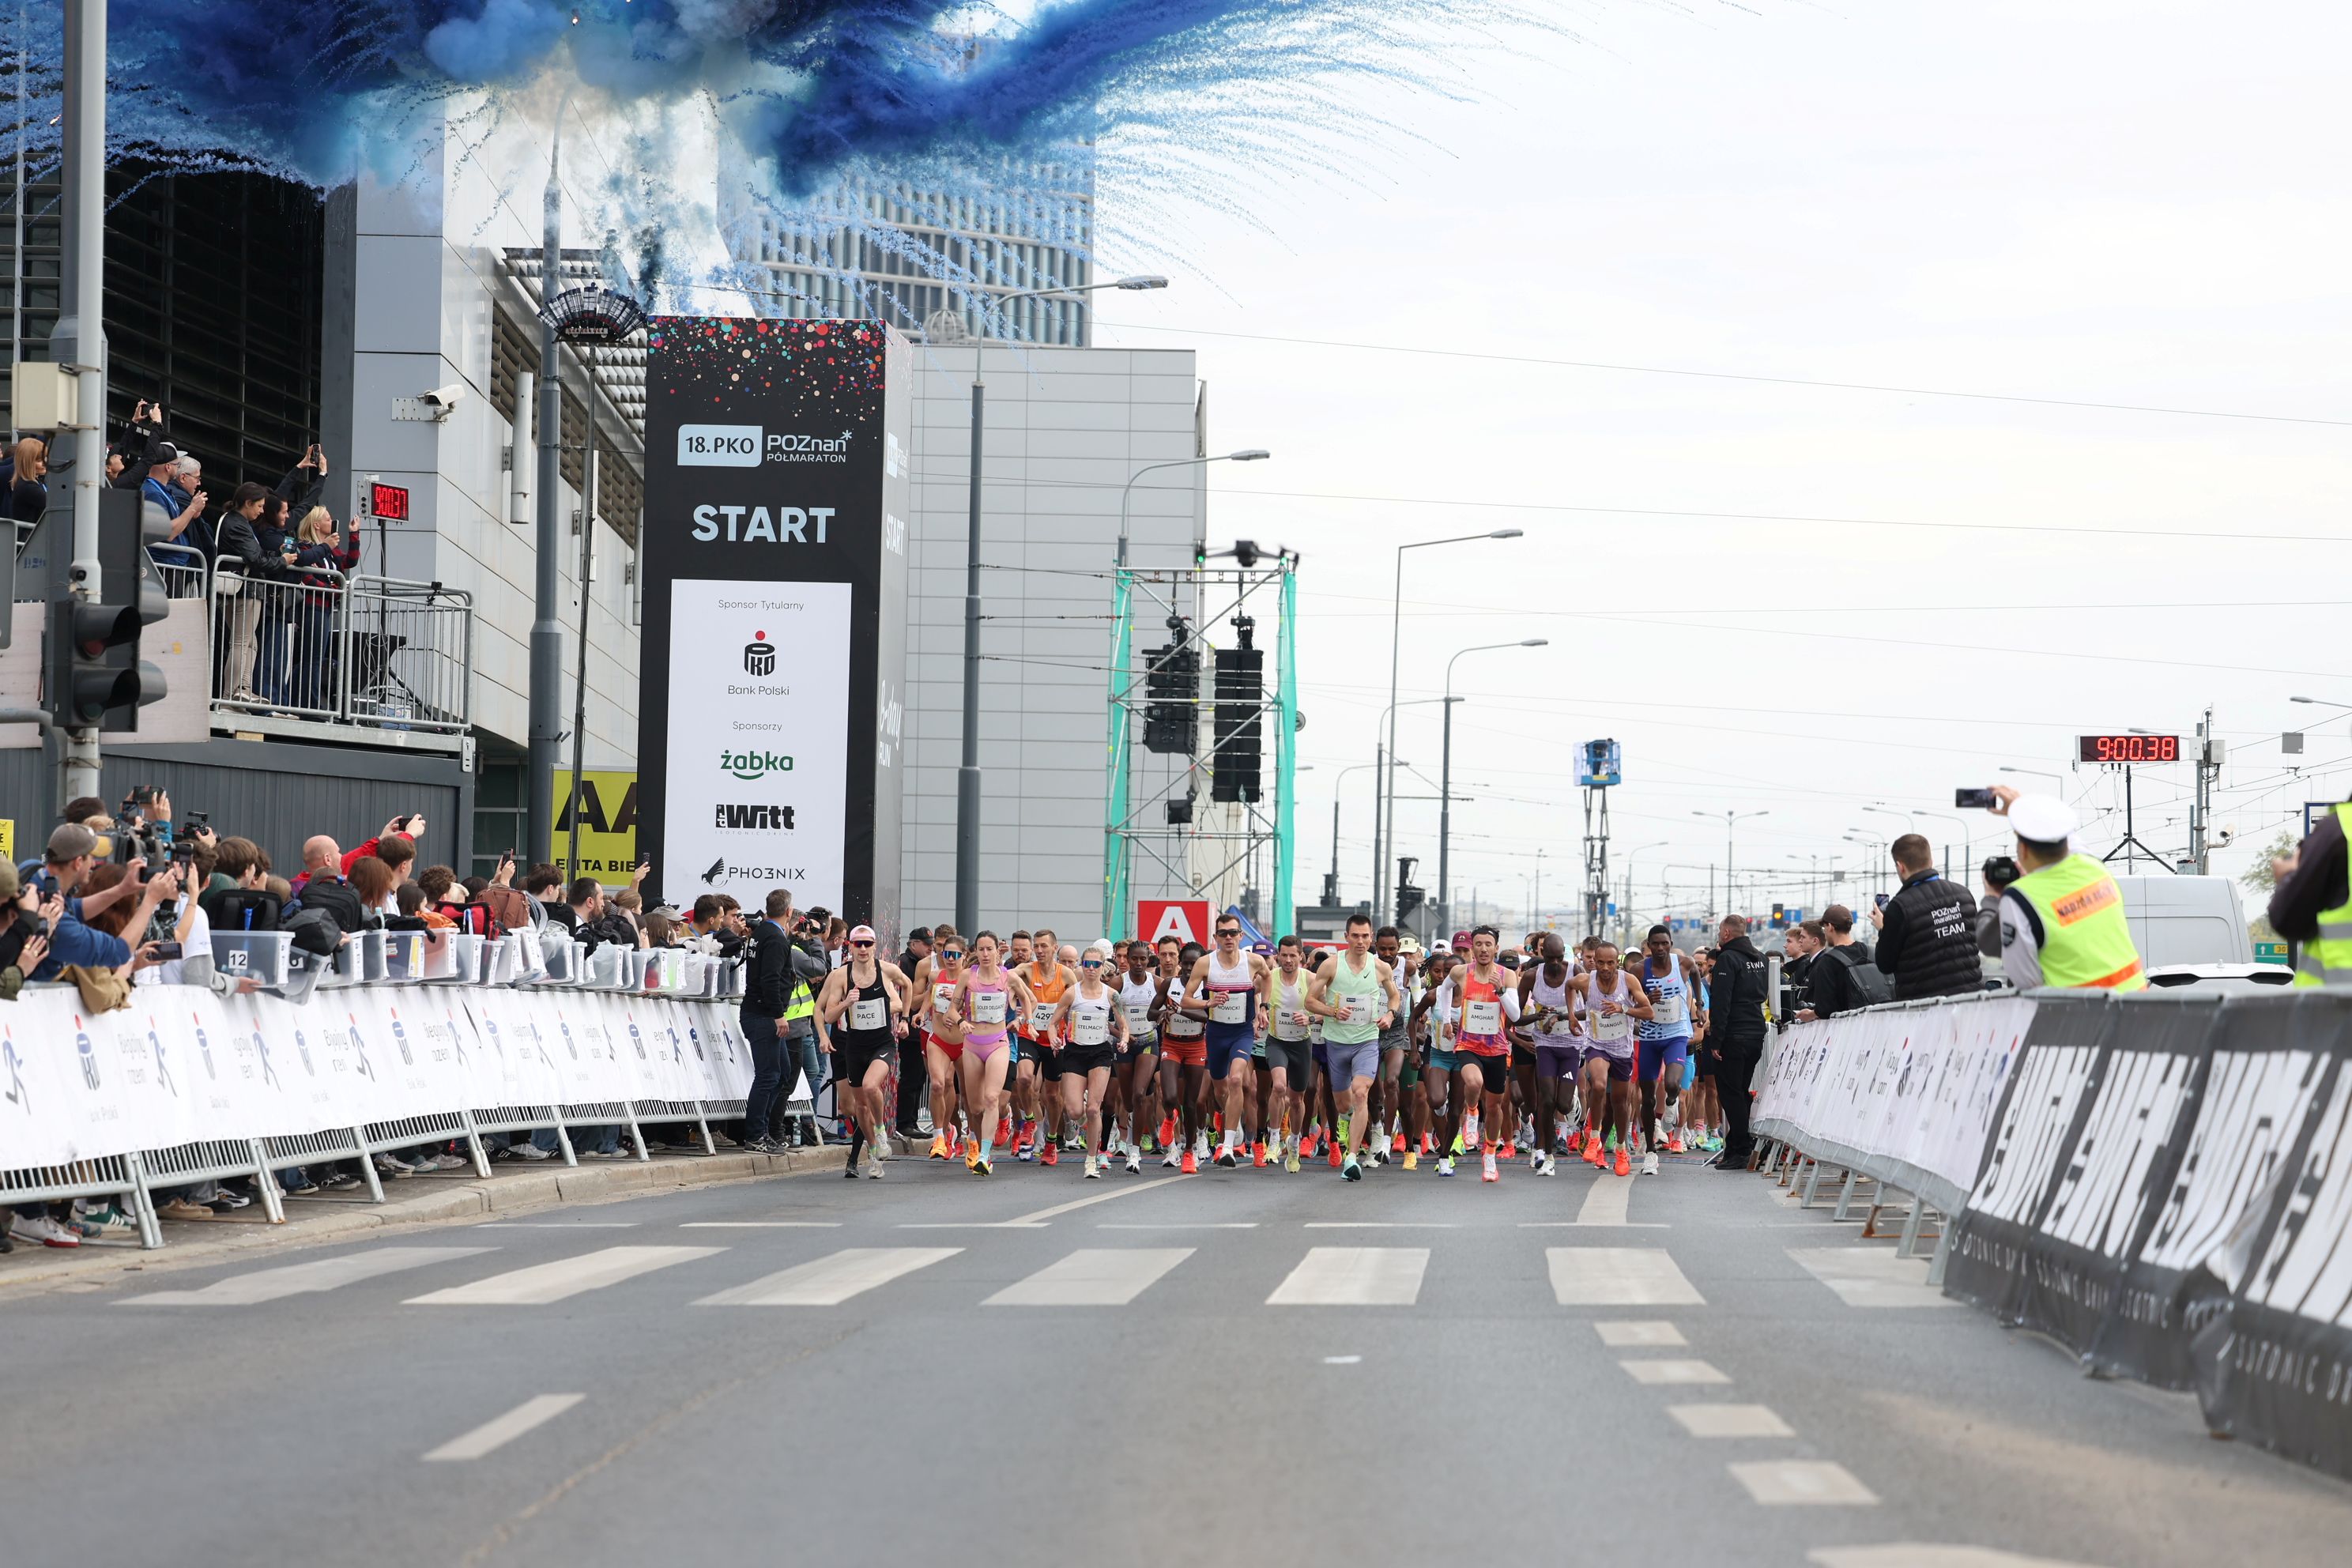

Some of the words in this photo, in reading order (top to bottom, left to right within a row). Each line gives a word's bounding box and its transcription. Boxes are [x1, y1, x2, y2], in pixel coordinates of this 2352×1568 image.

[686, 436, 755, 454] 18.PKO
[767, 452, 846, 463] PÓŁMARATON
[692, 504, 835, 544] START
[886, 513, 905, 556] START
[718, 599, 758, 611] Sponsor
[761, 600, 805, 612] Tytularny
[728, 685, 756, 695] Bank
[758, 686, 790, 696] Polski
[733, 721, 782, 733] Sponsorzy
[2097, 737, 2175, 761] 9:00.38
[721, 749, 793, 771] żabka
[726, 805, 795, 830] Witt
[1150, 906, 1197, 949] A
[1934, 922, 1966, 939] TEAM
[229, 953, 247, 967] 12
